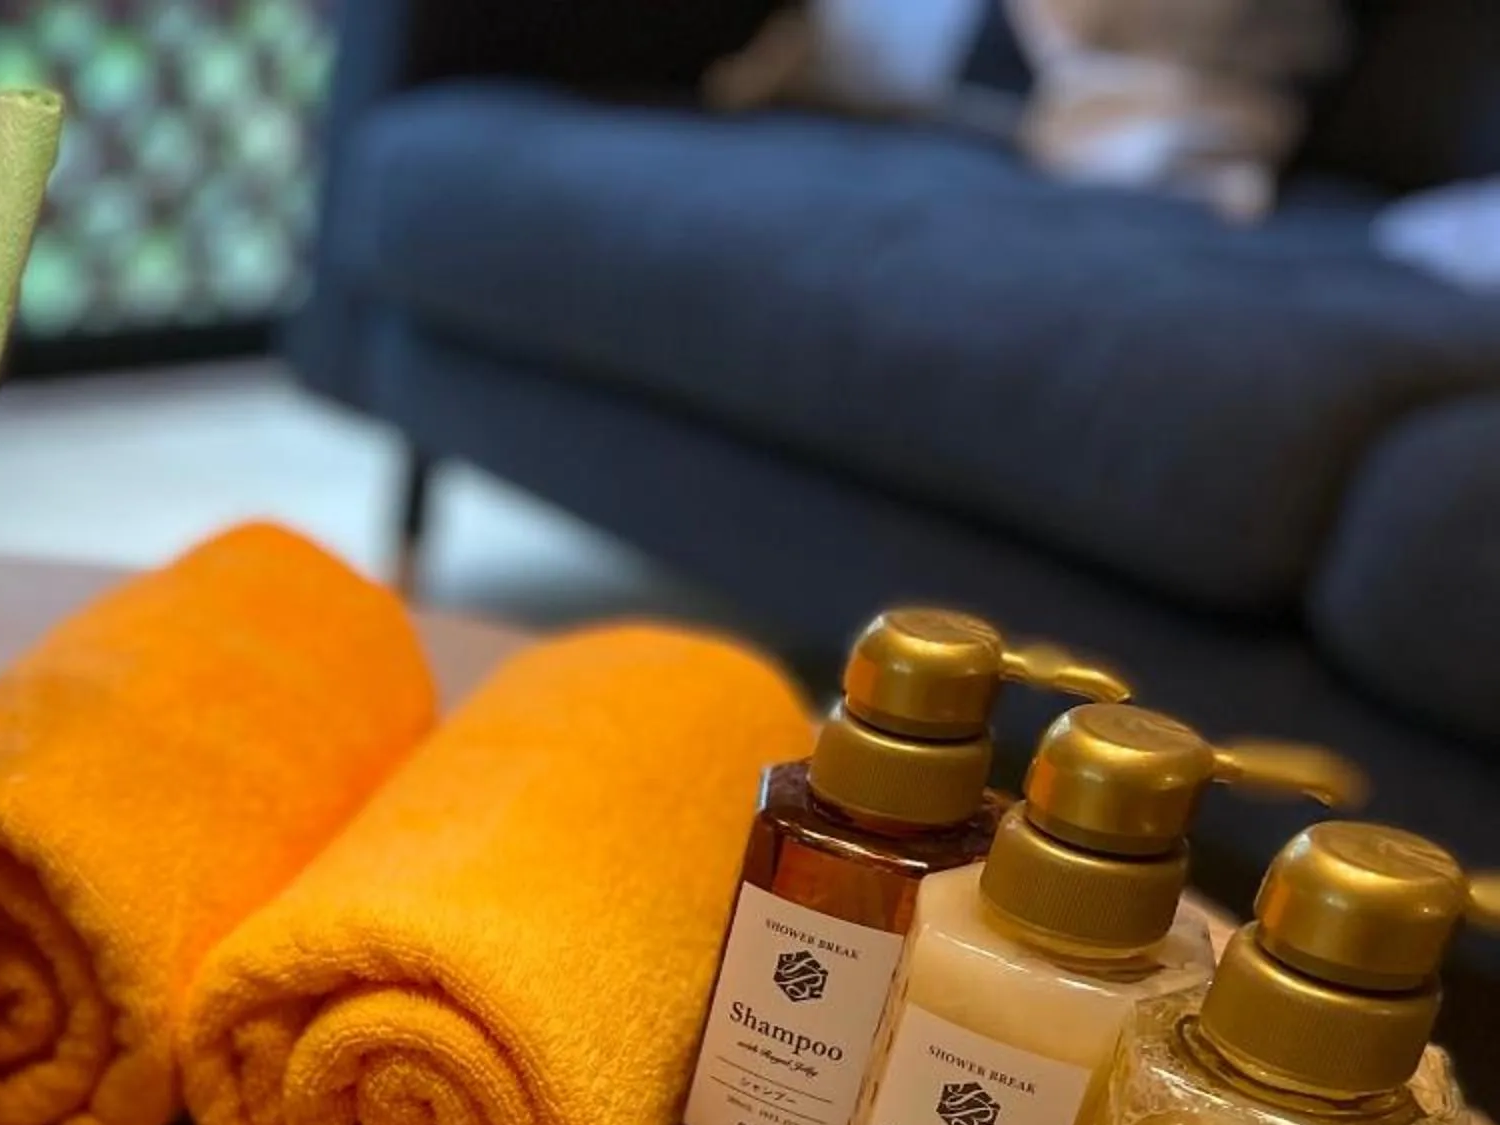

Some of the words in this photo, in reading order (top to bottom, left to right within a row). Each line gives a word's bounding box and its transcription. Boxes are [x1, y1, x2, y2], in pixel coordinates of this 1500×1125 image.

[765, 917, 815, 946] SHOWER
[816, 938, 860, 961] BREAK
[728, 1000, 844, 1062] Shampoo
[928, 1044, 986, 1080] SHOWER
[989, 1068, 1036, 1096] BREAK
